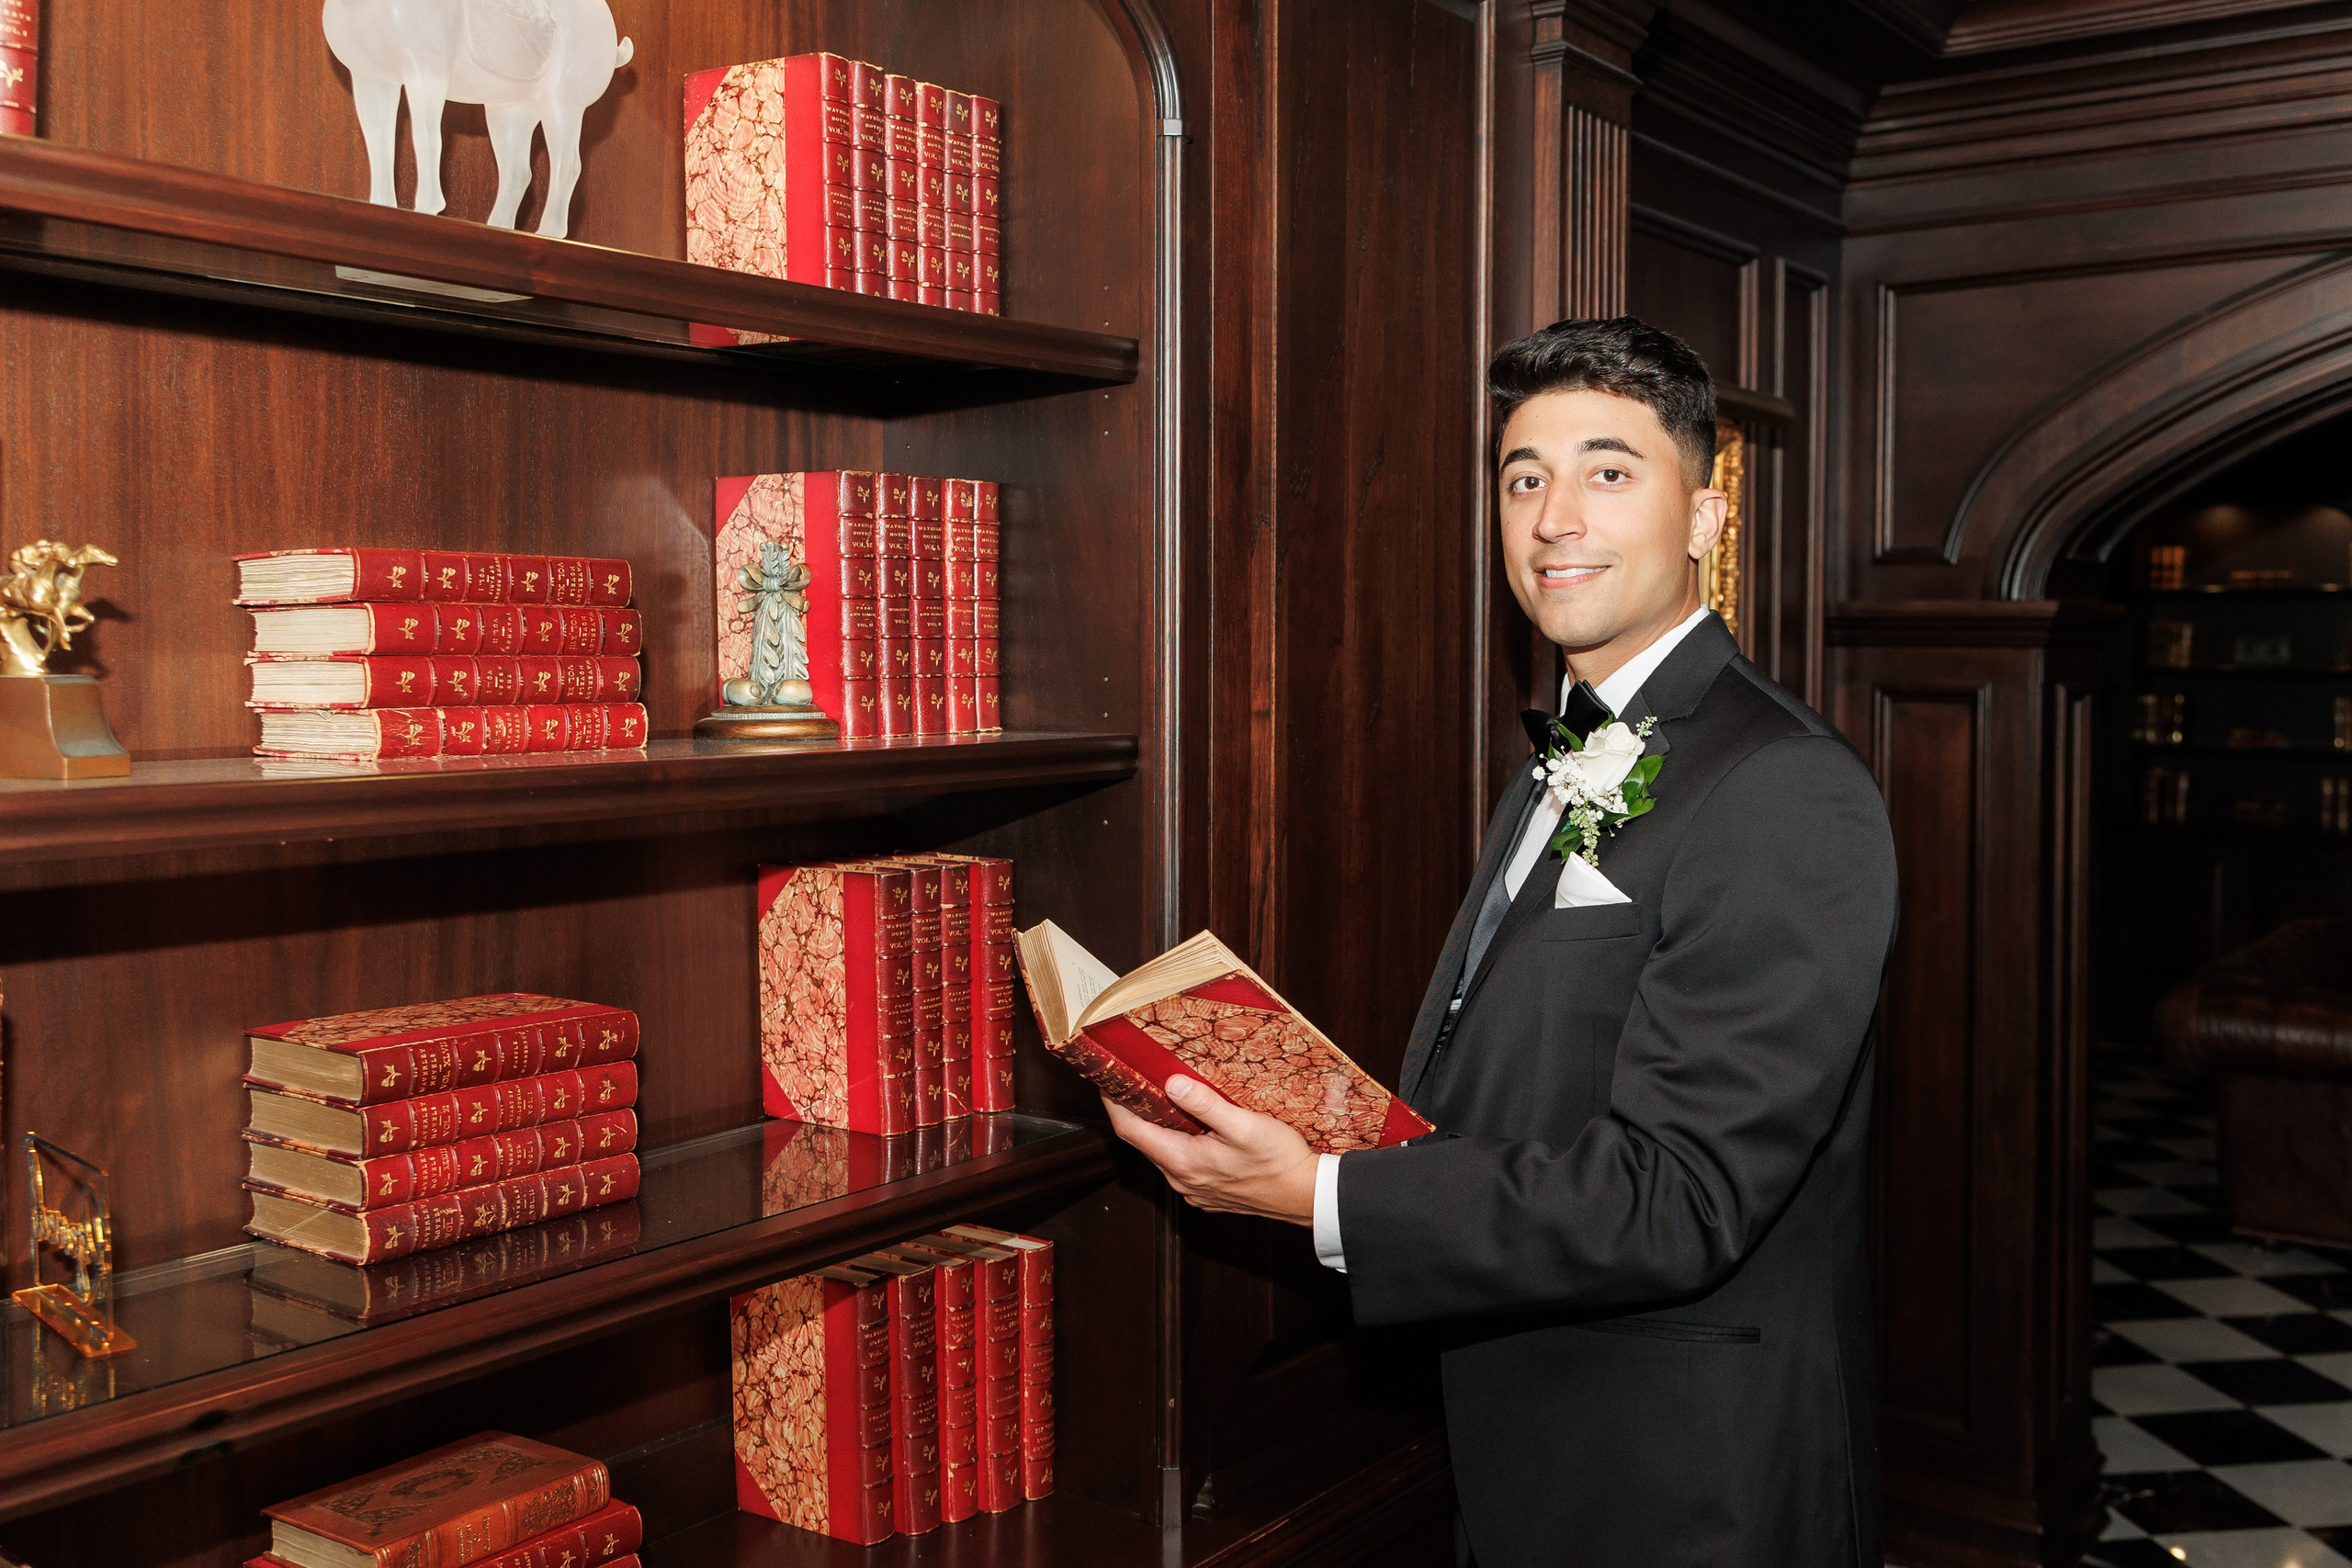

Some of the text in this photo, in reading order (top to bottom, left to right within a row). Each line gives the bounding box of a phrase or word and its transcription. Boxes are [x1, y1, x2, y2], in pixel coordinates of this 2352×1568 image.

[861, 134, 876, 143] VOL.
[895, 144, 910, 153] VOL.
[951, 158, 965, 167] VOL.
[976, 161, 991, 170] VOL.
[489, 565, 494, 574] OF
[575, 561, 583, 604] WAVERLEY
[557, 583, 565, 603] XLV
[588, 611, 596, 652] WAVERLEY
[569, 635, 578, 649] XVII
[585, 660, 594, 700] WAVERLEY
[567, 687, 575, 696] XX
[592, 707, 600, 749] WAVERLEY
[439, 1042, 451, 1067] XLVII
[419, 1049, 428, 1093] WAVERLEY
[508, 1090, 514, 1099] OF
[442, 1105, 450, 1113] XI
[420, 1102, 429, 1146] WAVERLEY
[419, 1153, 428, 1197] WAVERLEY
[420, 1204, 431, 1248] WAVERLEY
